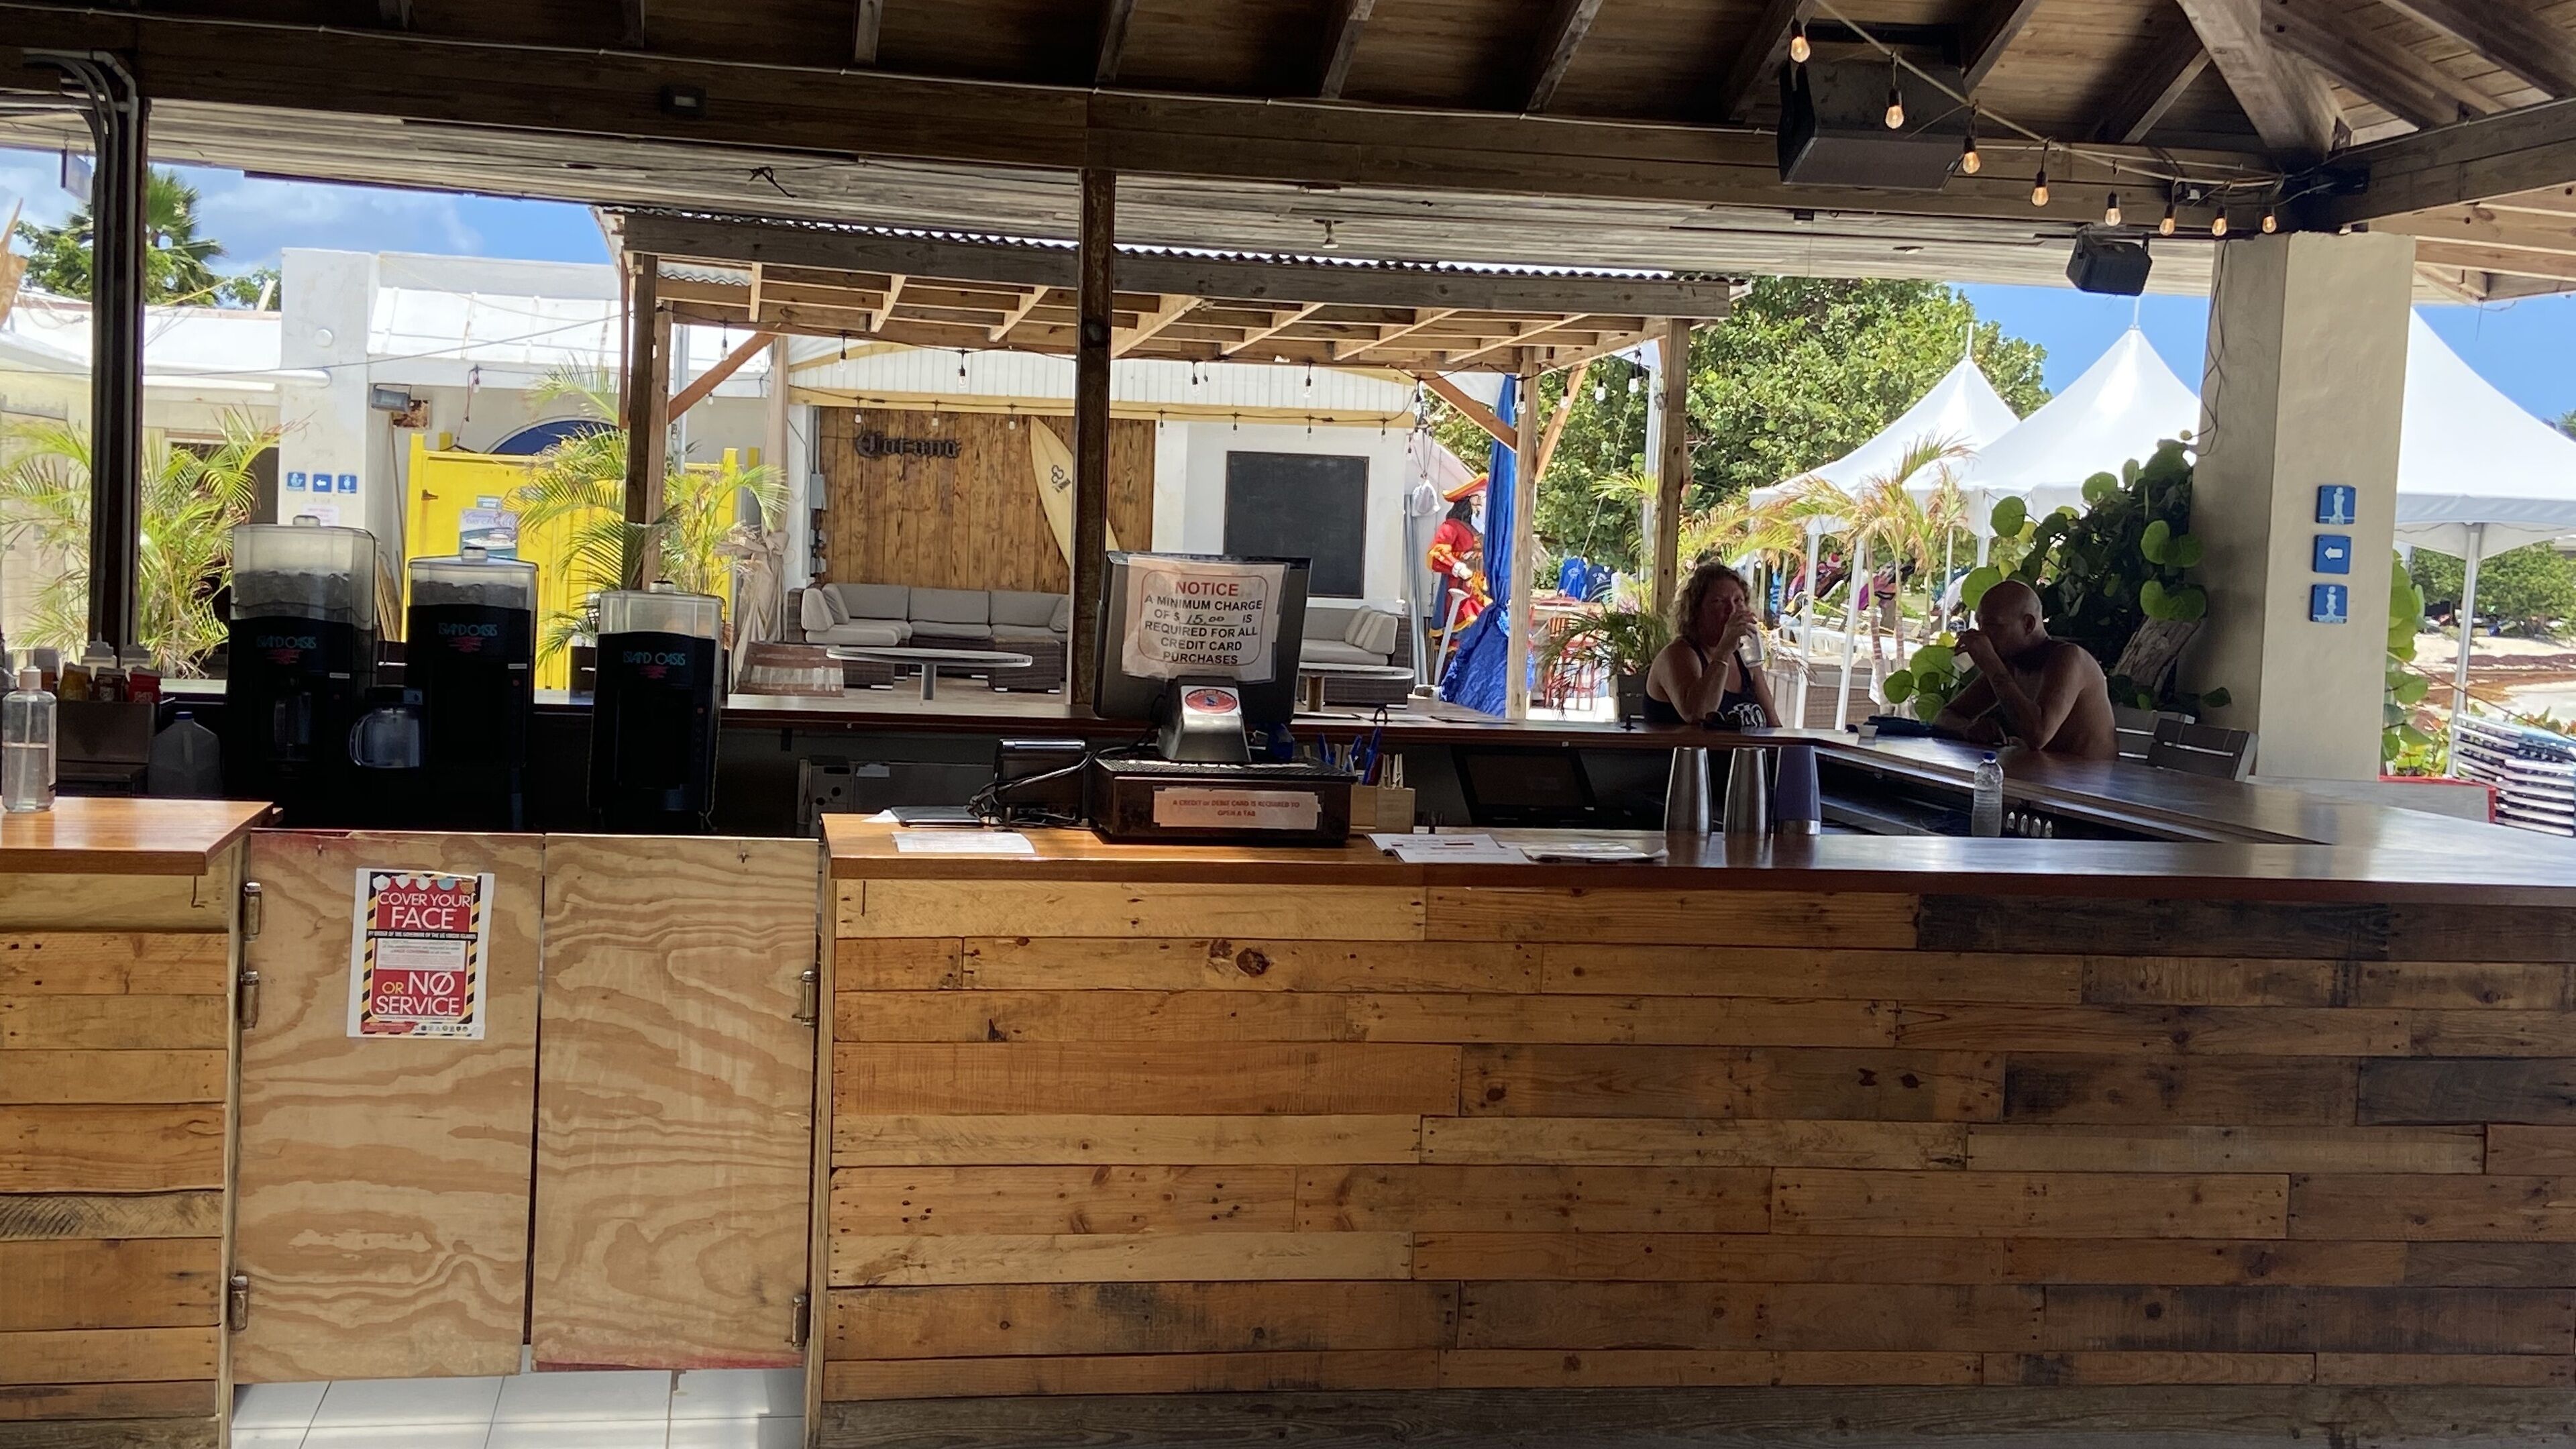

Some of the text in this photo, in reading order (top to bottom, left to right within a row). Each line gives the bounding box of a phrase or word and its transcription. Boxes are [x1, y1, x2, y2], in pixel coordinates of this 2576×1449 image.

[855, 429, 962, 461] Corona
[1175, 582, 1240, 596] NOTICE
[1144, 594, 1263, 610] A MINIMUM CHARGE
[1155, 609, 1170, 619] OF
[1242, 614, 1252, 624] IS
[1144, 621, 1258, 638] REQUIRED FOR ALL
[1161, 637, 1242, 651] CREDIT CARD
[1163, 651, 1238, 664] PURCHASES
[378, 892, 471, 908] COVER YOUR
[391, 907, 458, 930] FACE
[382, 981, 405, 994] OR
[376, 996, 460, 1016] SERVICE
